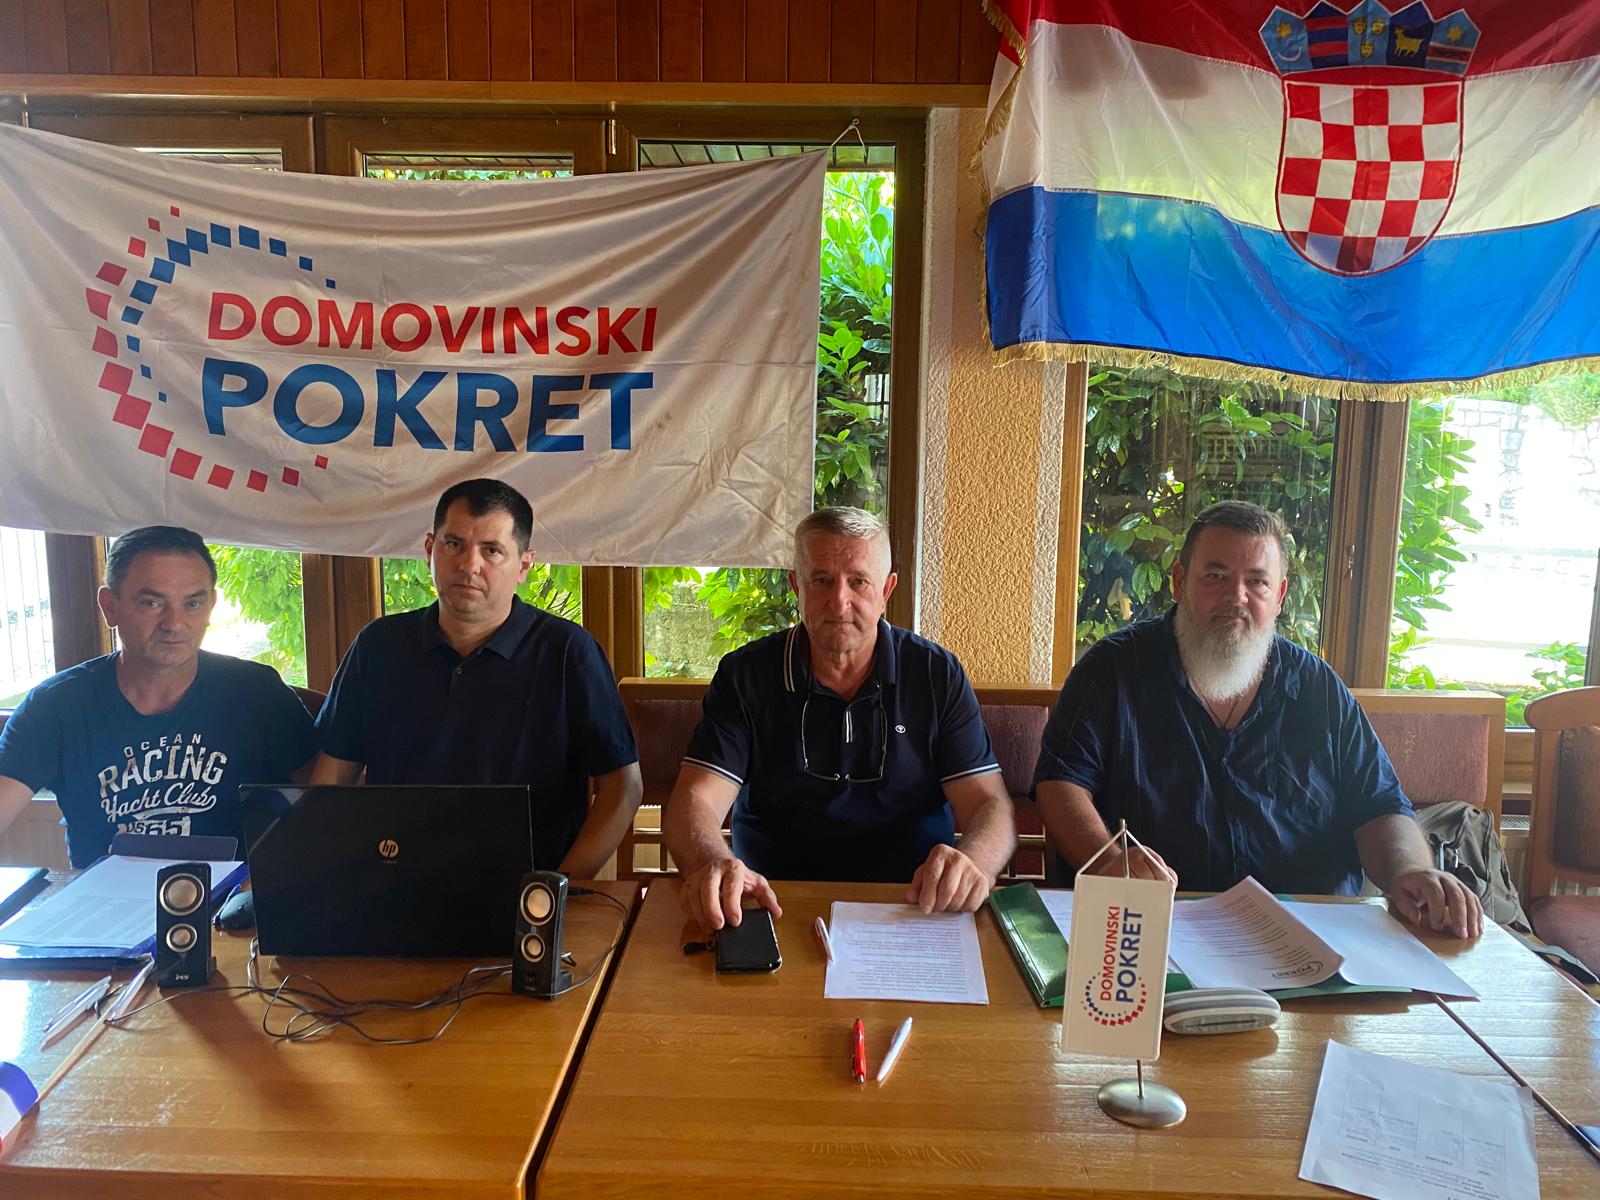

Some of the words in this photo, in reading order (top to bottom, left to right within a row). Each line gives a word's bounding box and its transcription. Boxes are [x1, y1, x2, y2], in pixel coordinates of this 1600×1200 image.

[207, 291, 658, 357] DOMOVINSKI
[201, 357, 654, 453] POKRET
[98, 745, 228, 799] RACING
[123, 733, 202, 758] OCEAN
[101, 788, 162, 823] Yacht
[163, 782, 217, 807] Club
[380, 840, 398, 858] hp
[1100, 905, 1120, 1001] DOMOVINSKI
[1115, 907, 1142, 1003] POKRET
